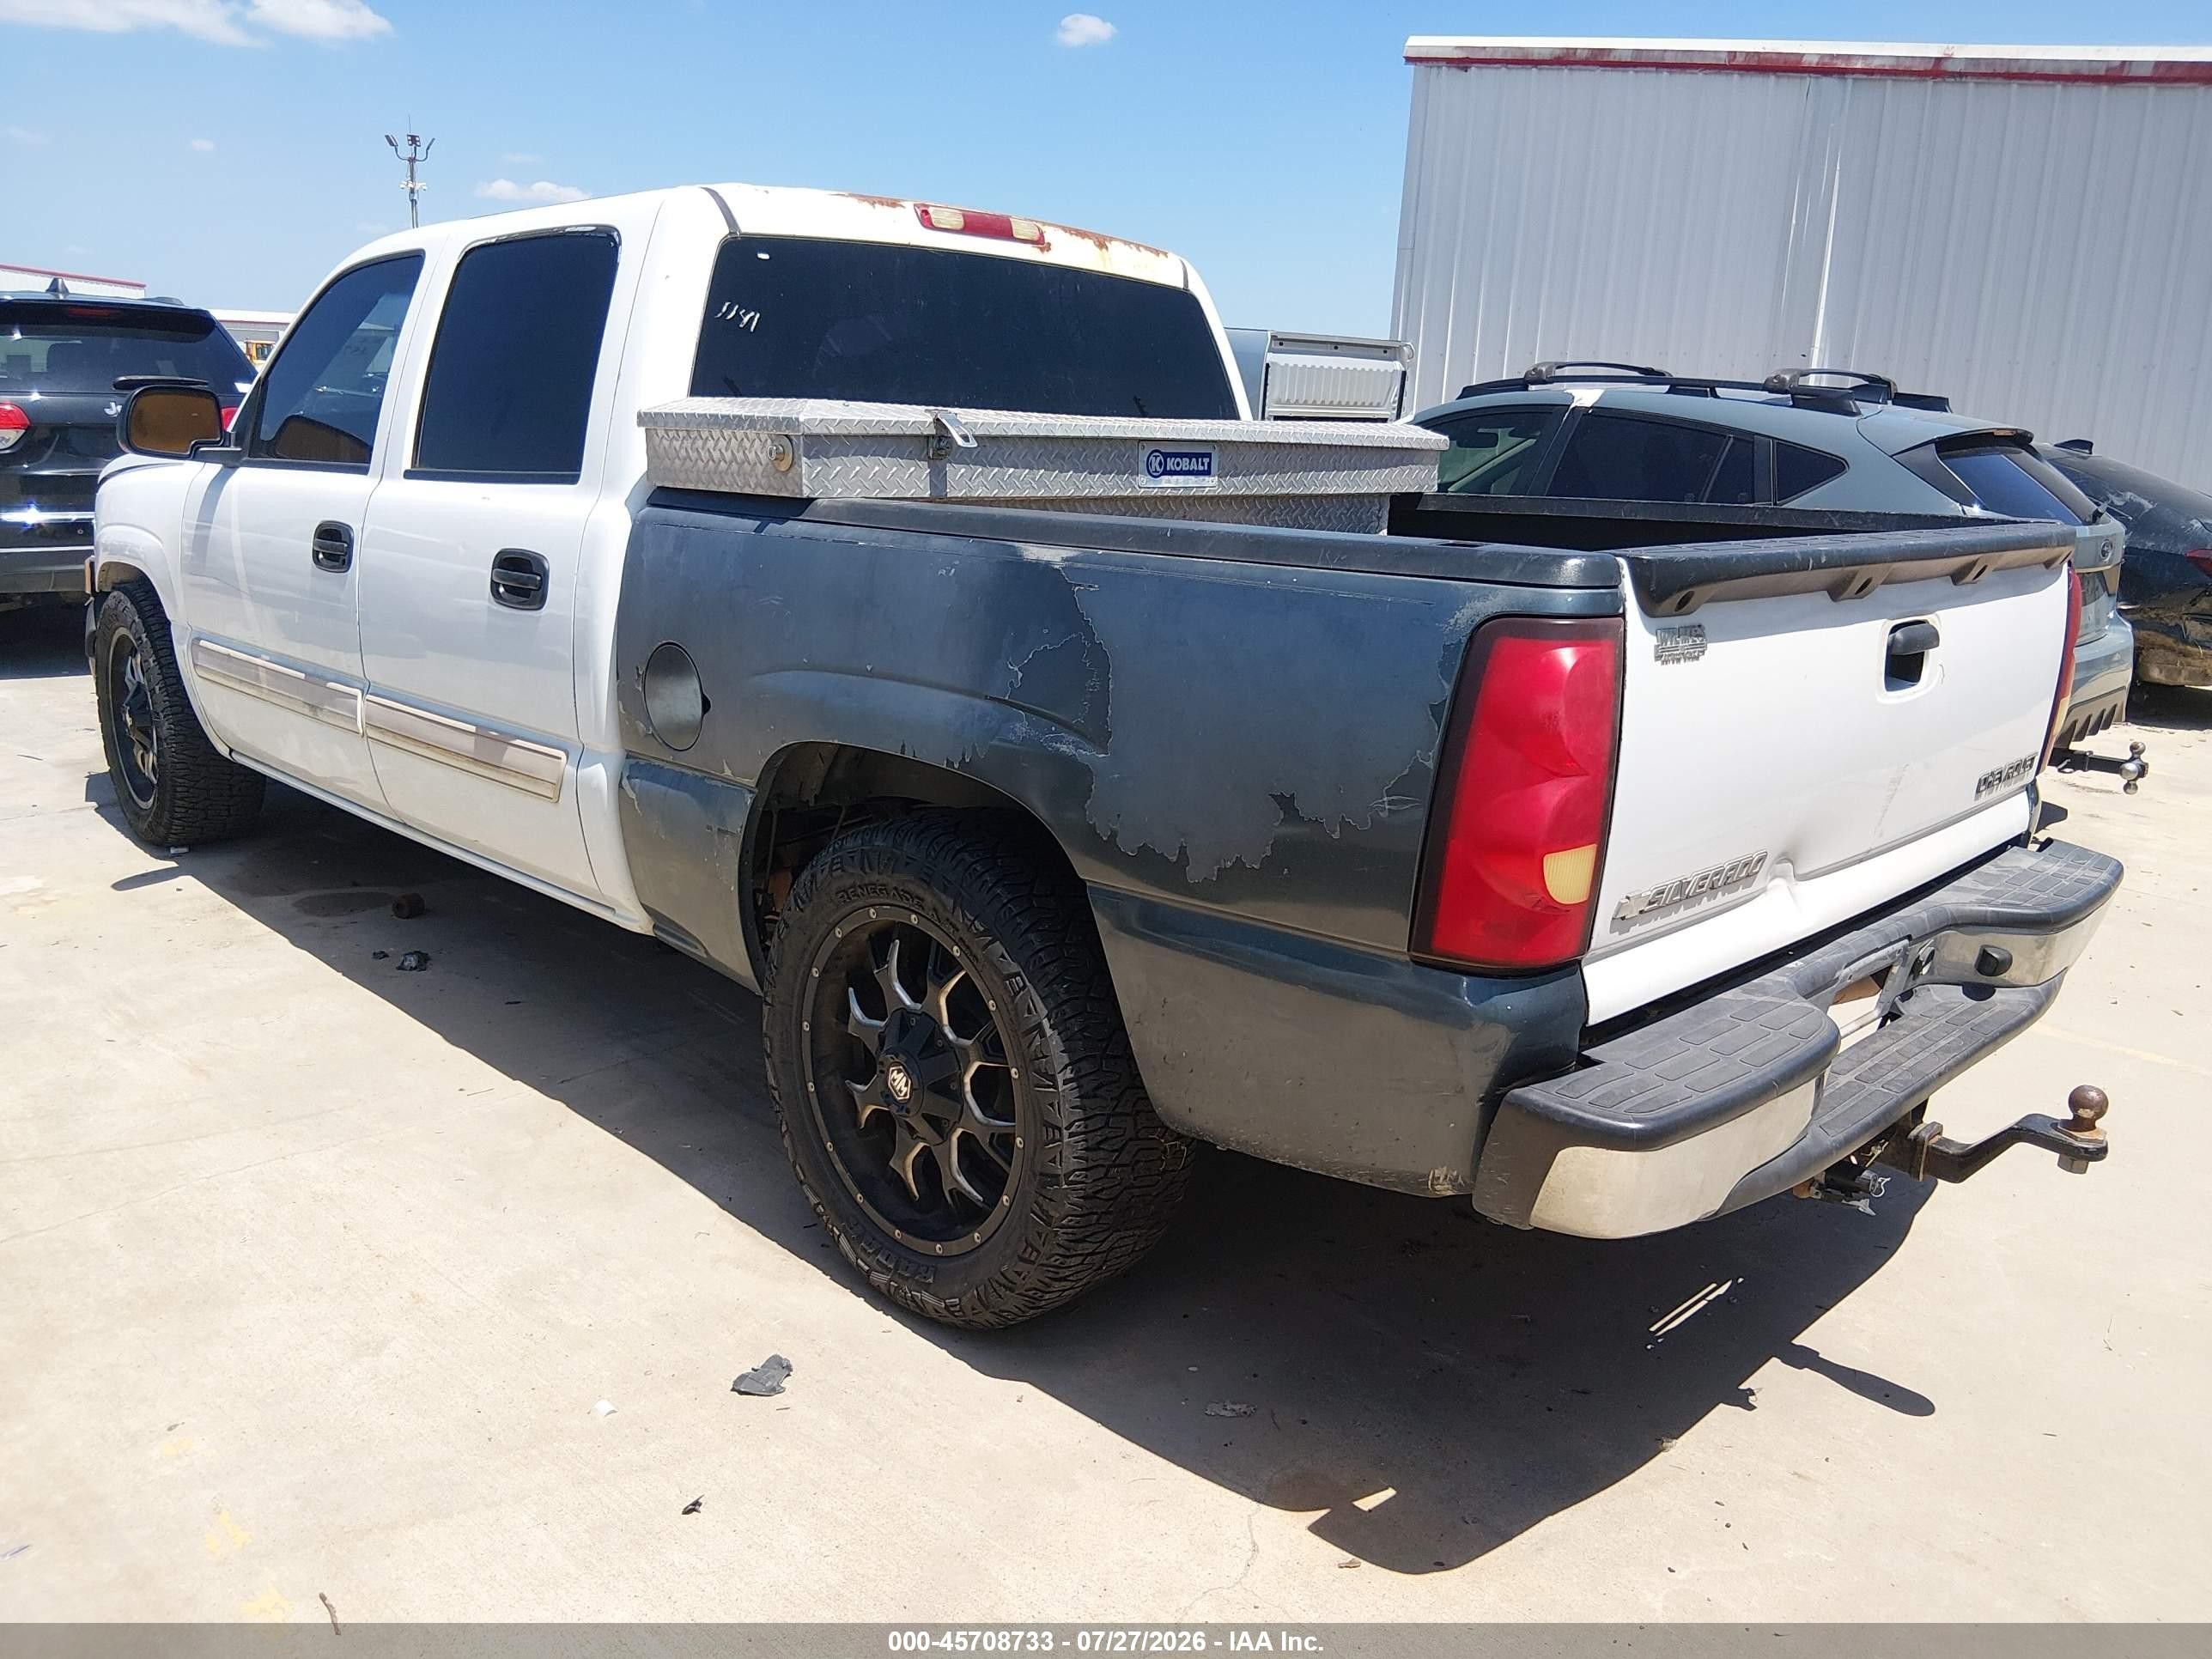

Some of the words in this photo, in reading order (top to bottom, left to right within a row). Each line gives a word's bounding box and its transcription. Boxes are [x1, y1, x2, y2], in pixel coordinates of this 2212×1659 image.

[1166, 457, 1210, 471] KOBALT
[1641, 850, 1769, 914] SILVERADO
[836, 884, 926, 910] RENEGADE
